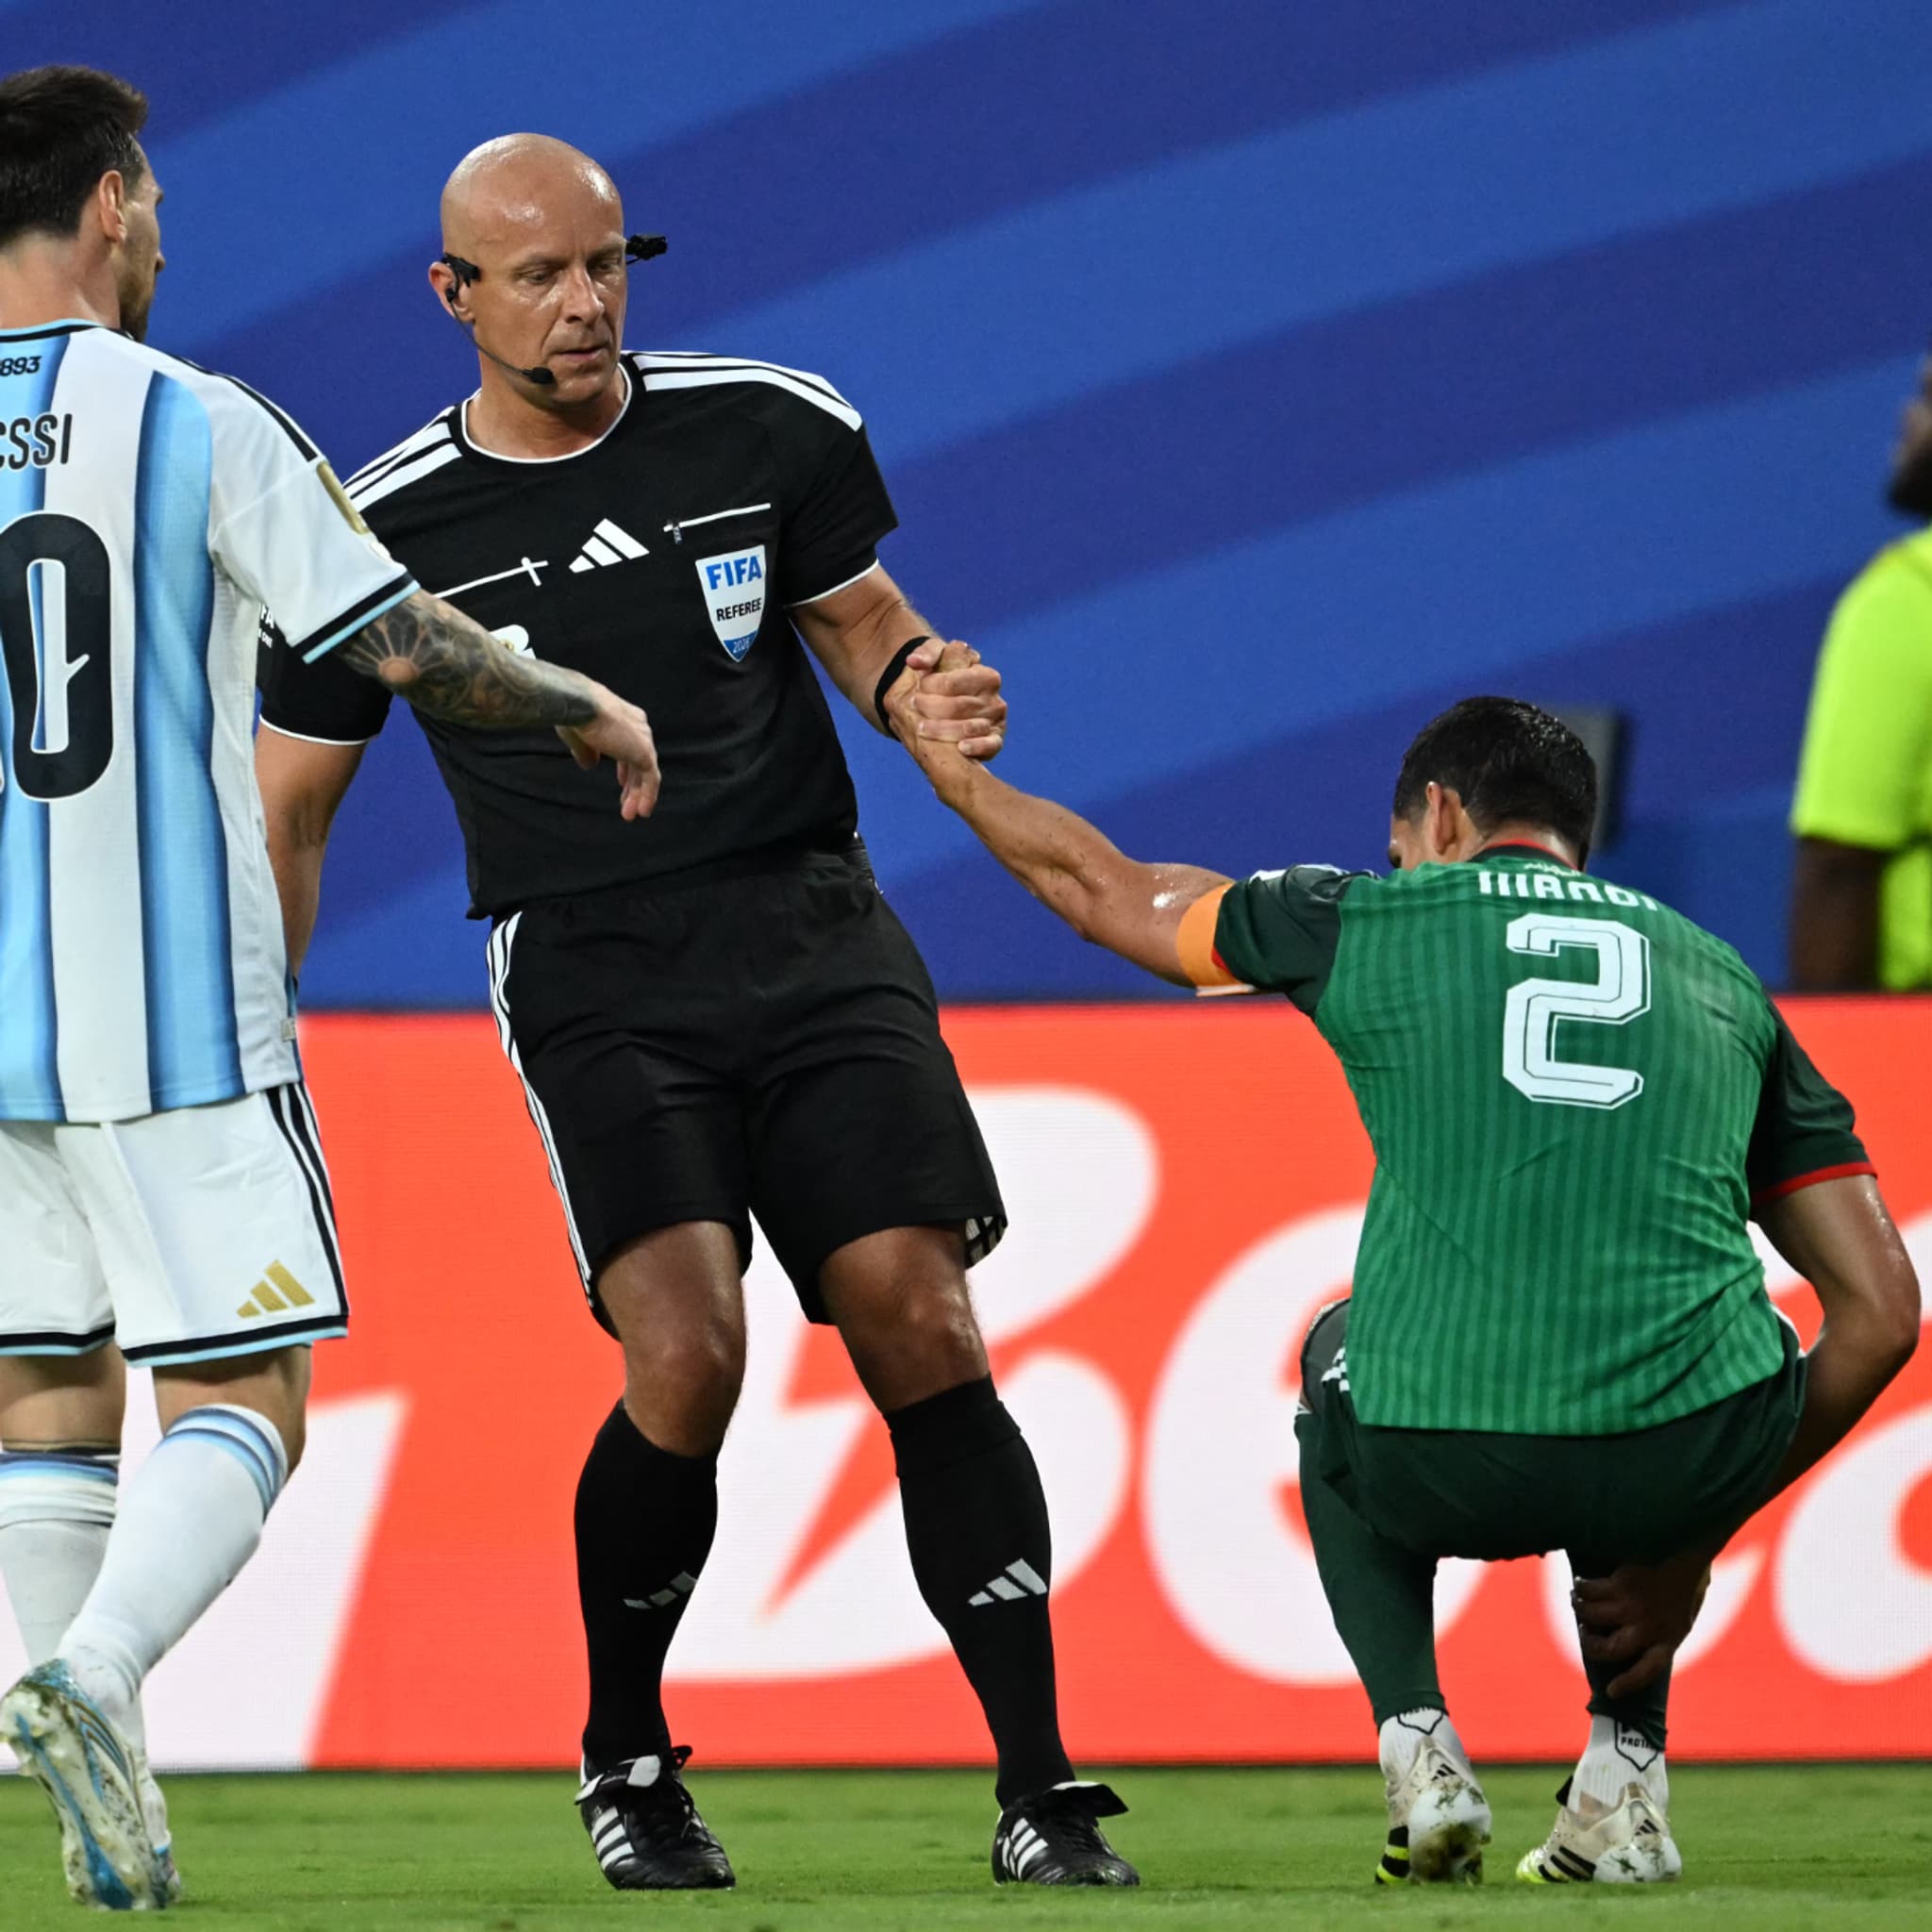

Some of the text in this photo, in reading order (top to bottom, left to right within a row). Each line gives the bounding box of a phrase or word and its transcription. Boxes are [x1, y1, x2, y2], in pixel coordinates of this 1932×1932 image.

[706, 555, 762, 591] FIFA
[716, 597, 762, 622] REFEREE
[0, 510, 112, 800] 0
[1503, 913, 1651, 1110] 2
